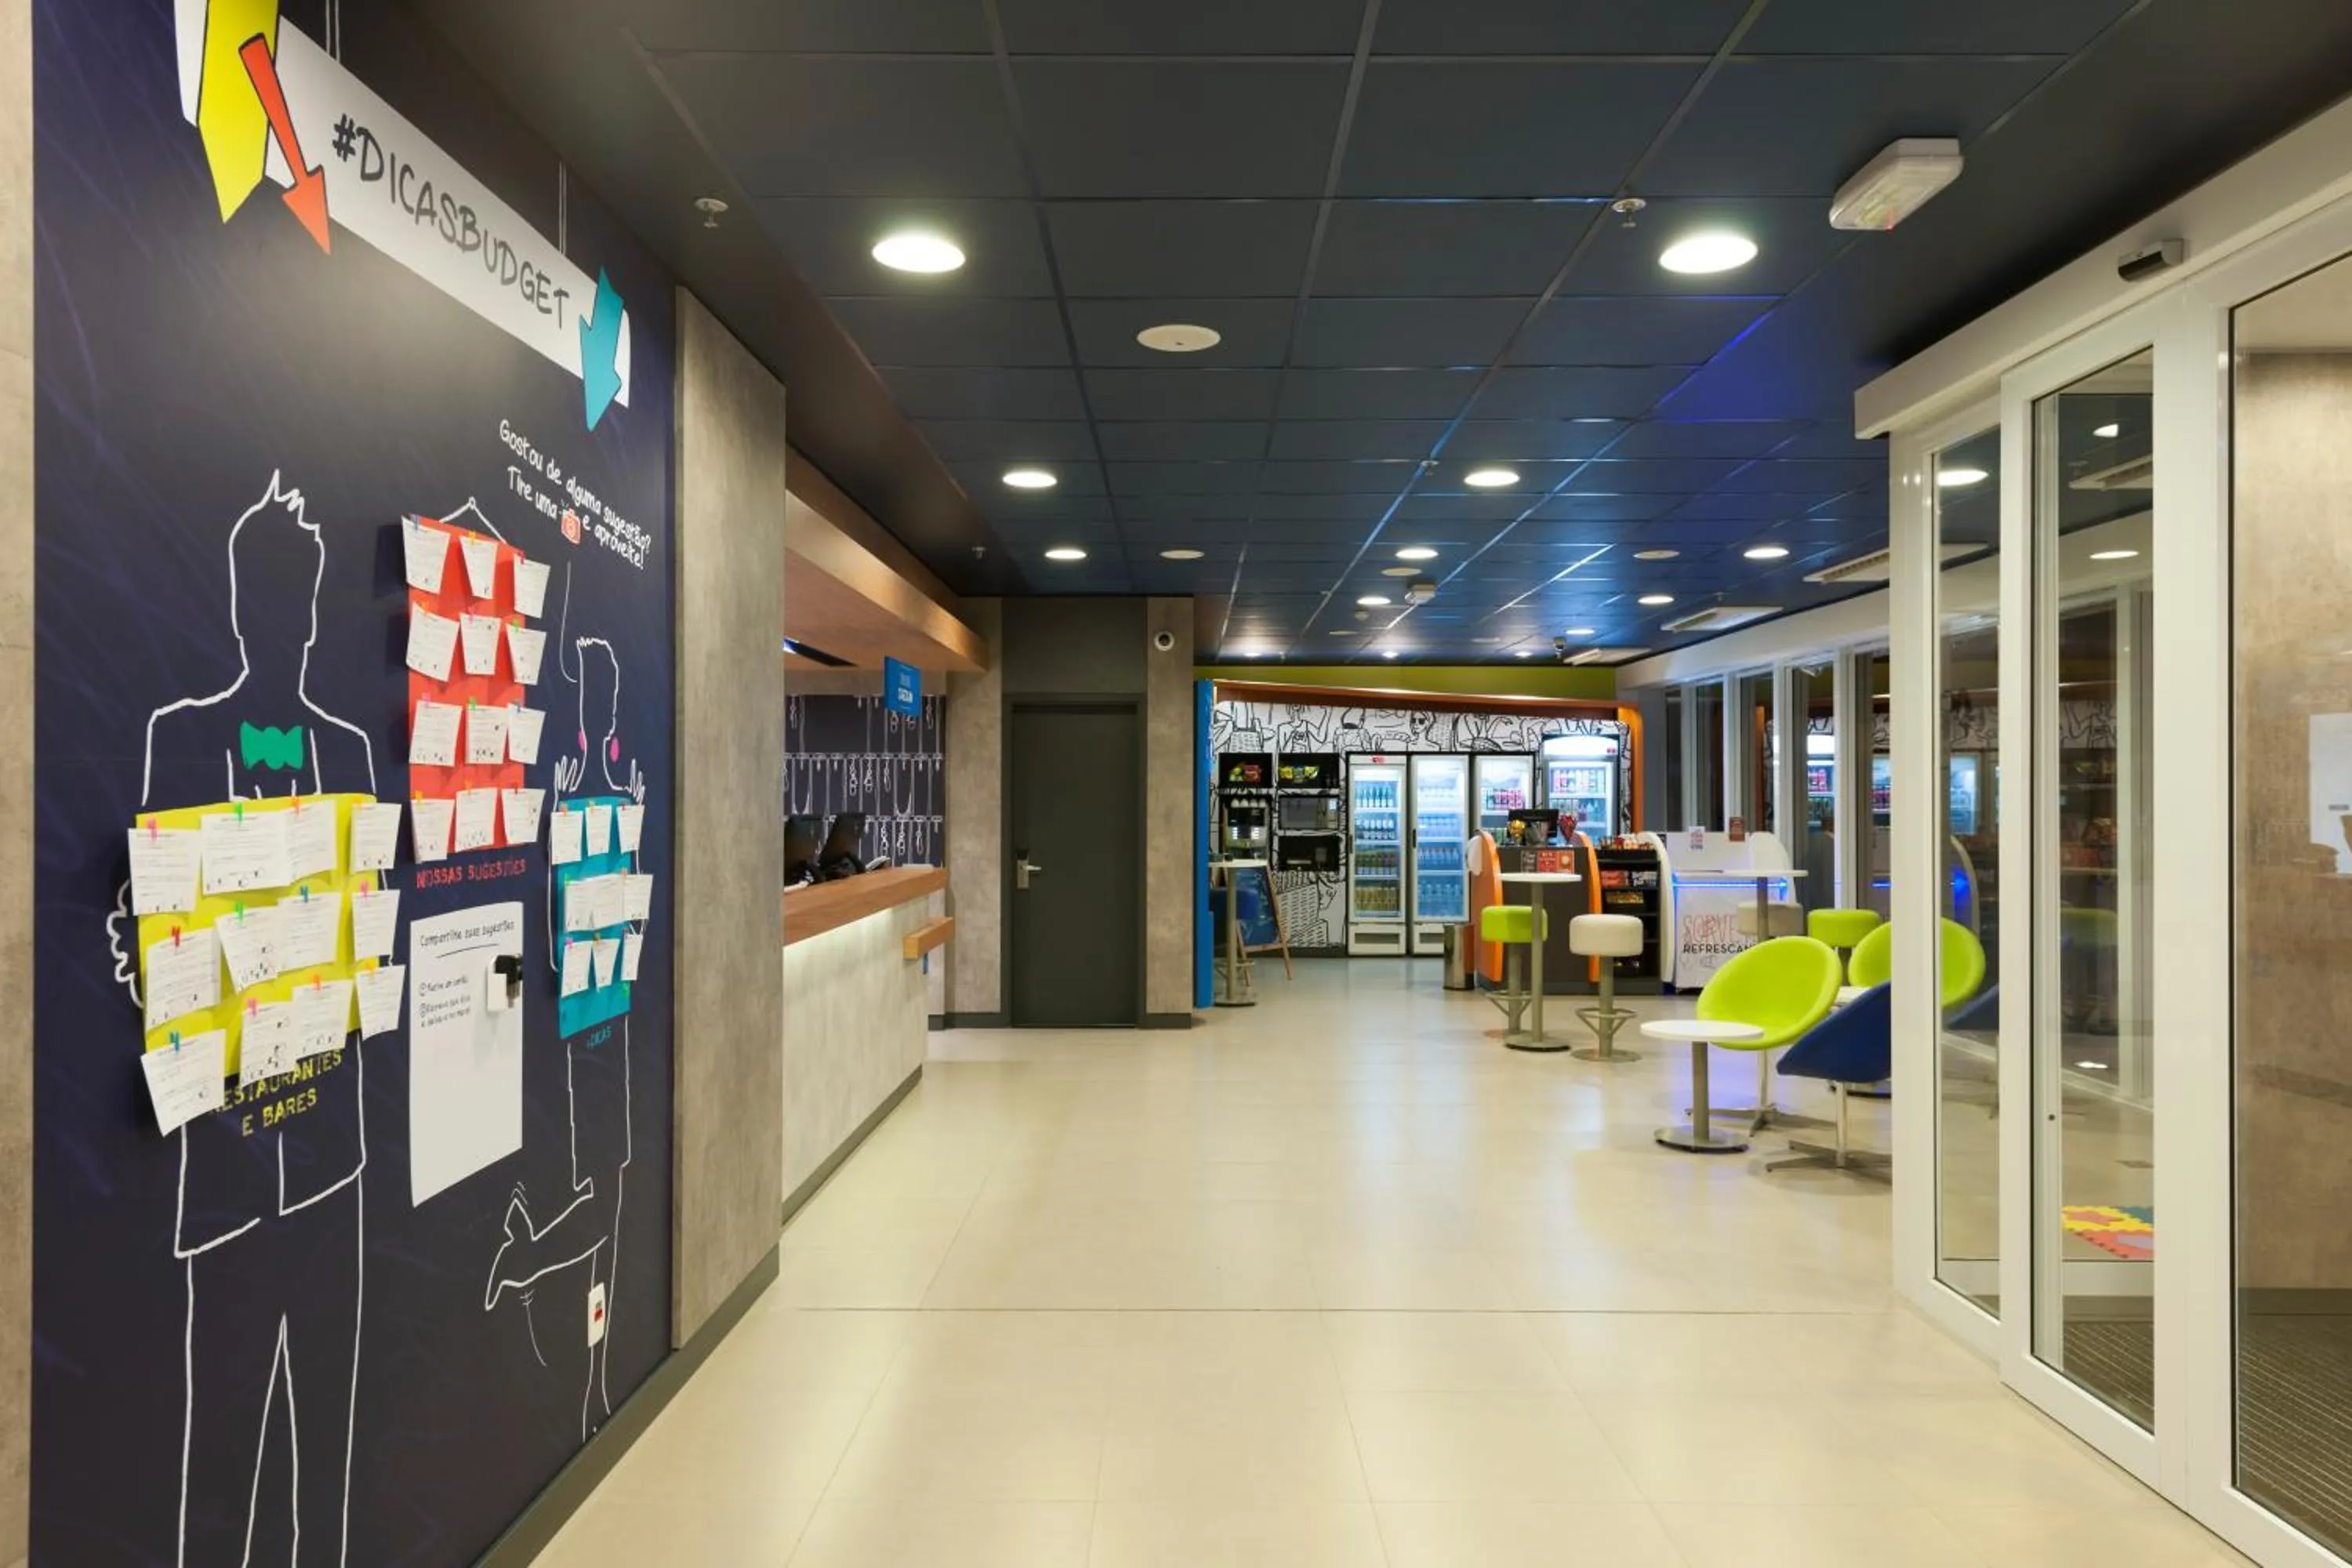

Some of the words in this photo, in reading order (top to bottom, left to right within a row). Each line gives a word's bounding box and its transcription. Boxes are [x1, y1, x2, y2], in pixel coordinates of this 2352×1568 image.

[332, 114, 570, 330] #DICASBUDGET
[499, 419, 543, 471] Gostou
[546, 459, 562, 485] de
[565, 477, 601, 514] alguma
[507, 466, 533, 502] Tire
[535, 492, 557, 520] uma
[583, 514, 591, 531] e
[594, 524, 644, 570] aproveite!
[416, 866, 463, 889] NOSSAS
[1682, 943, 1756, 954] REFRESCA
[216, 1049, 342, 1112] ESTAURANTES
[241, 1113, 255, 1137] E
[263, 1087, 318, 1128] BARES
